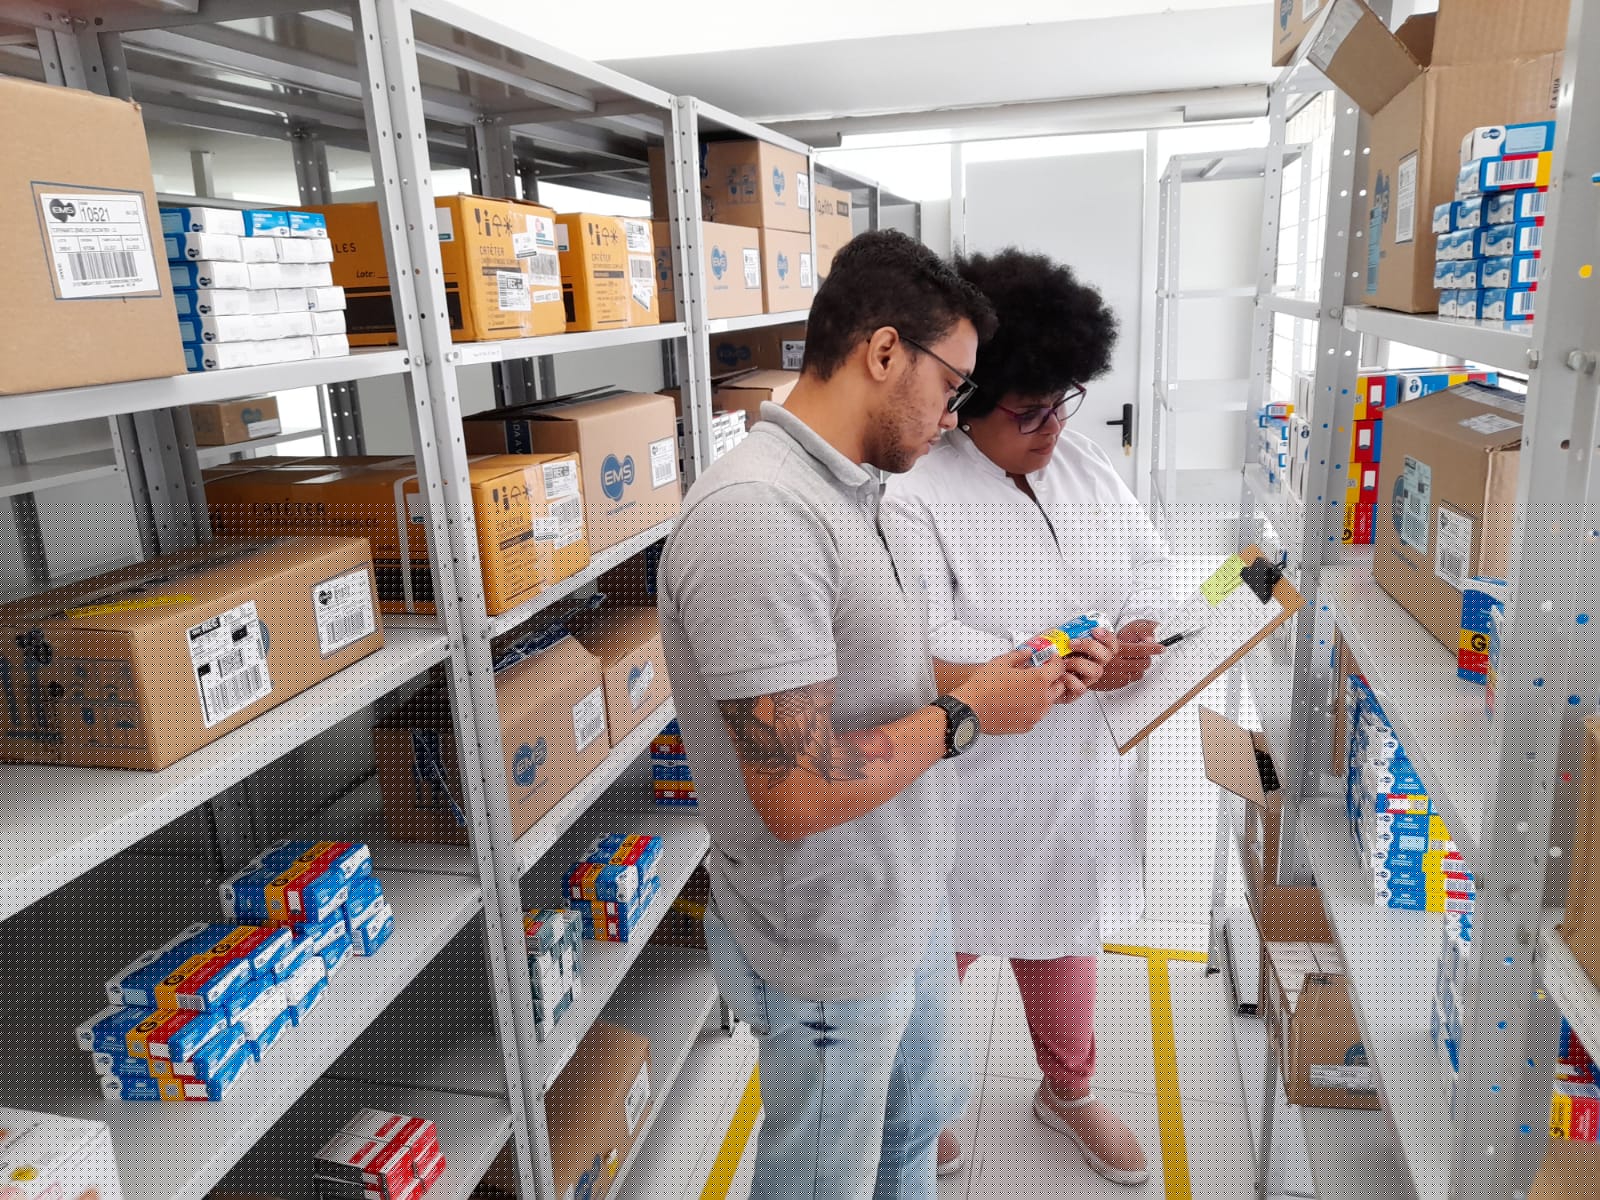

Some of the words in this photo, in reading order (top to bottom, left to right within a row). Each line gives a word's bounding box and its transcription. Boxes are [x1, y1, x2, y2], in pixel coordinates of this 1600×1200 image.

[81, 207, 111, 222] 10521
[604, 464, 632, 487] EMS
[1471, 633, 1488, 652] G
[516, 744, 545, 776] EMS
[211, 943, 232, 954] G
[163, 974, 185, 987] G
[135, 1021, 158, 1033] G
